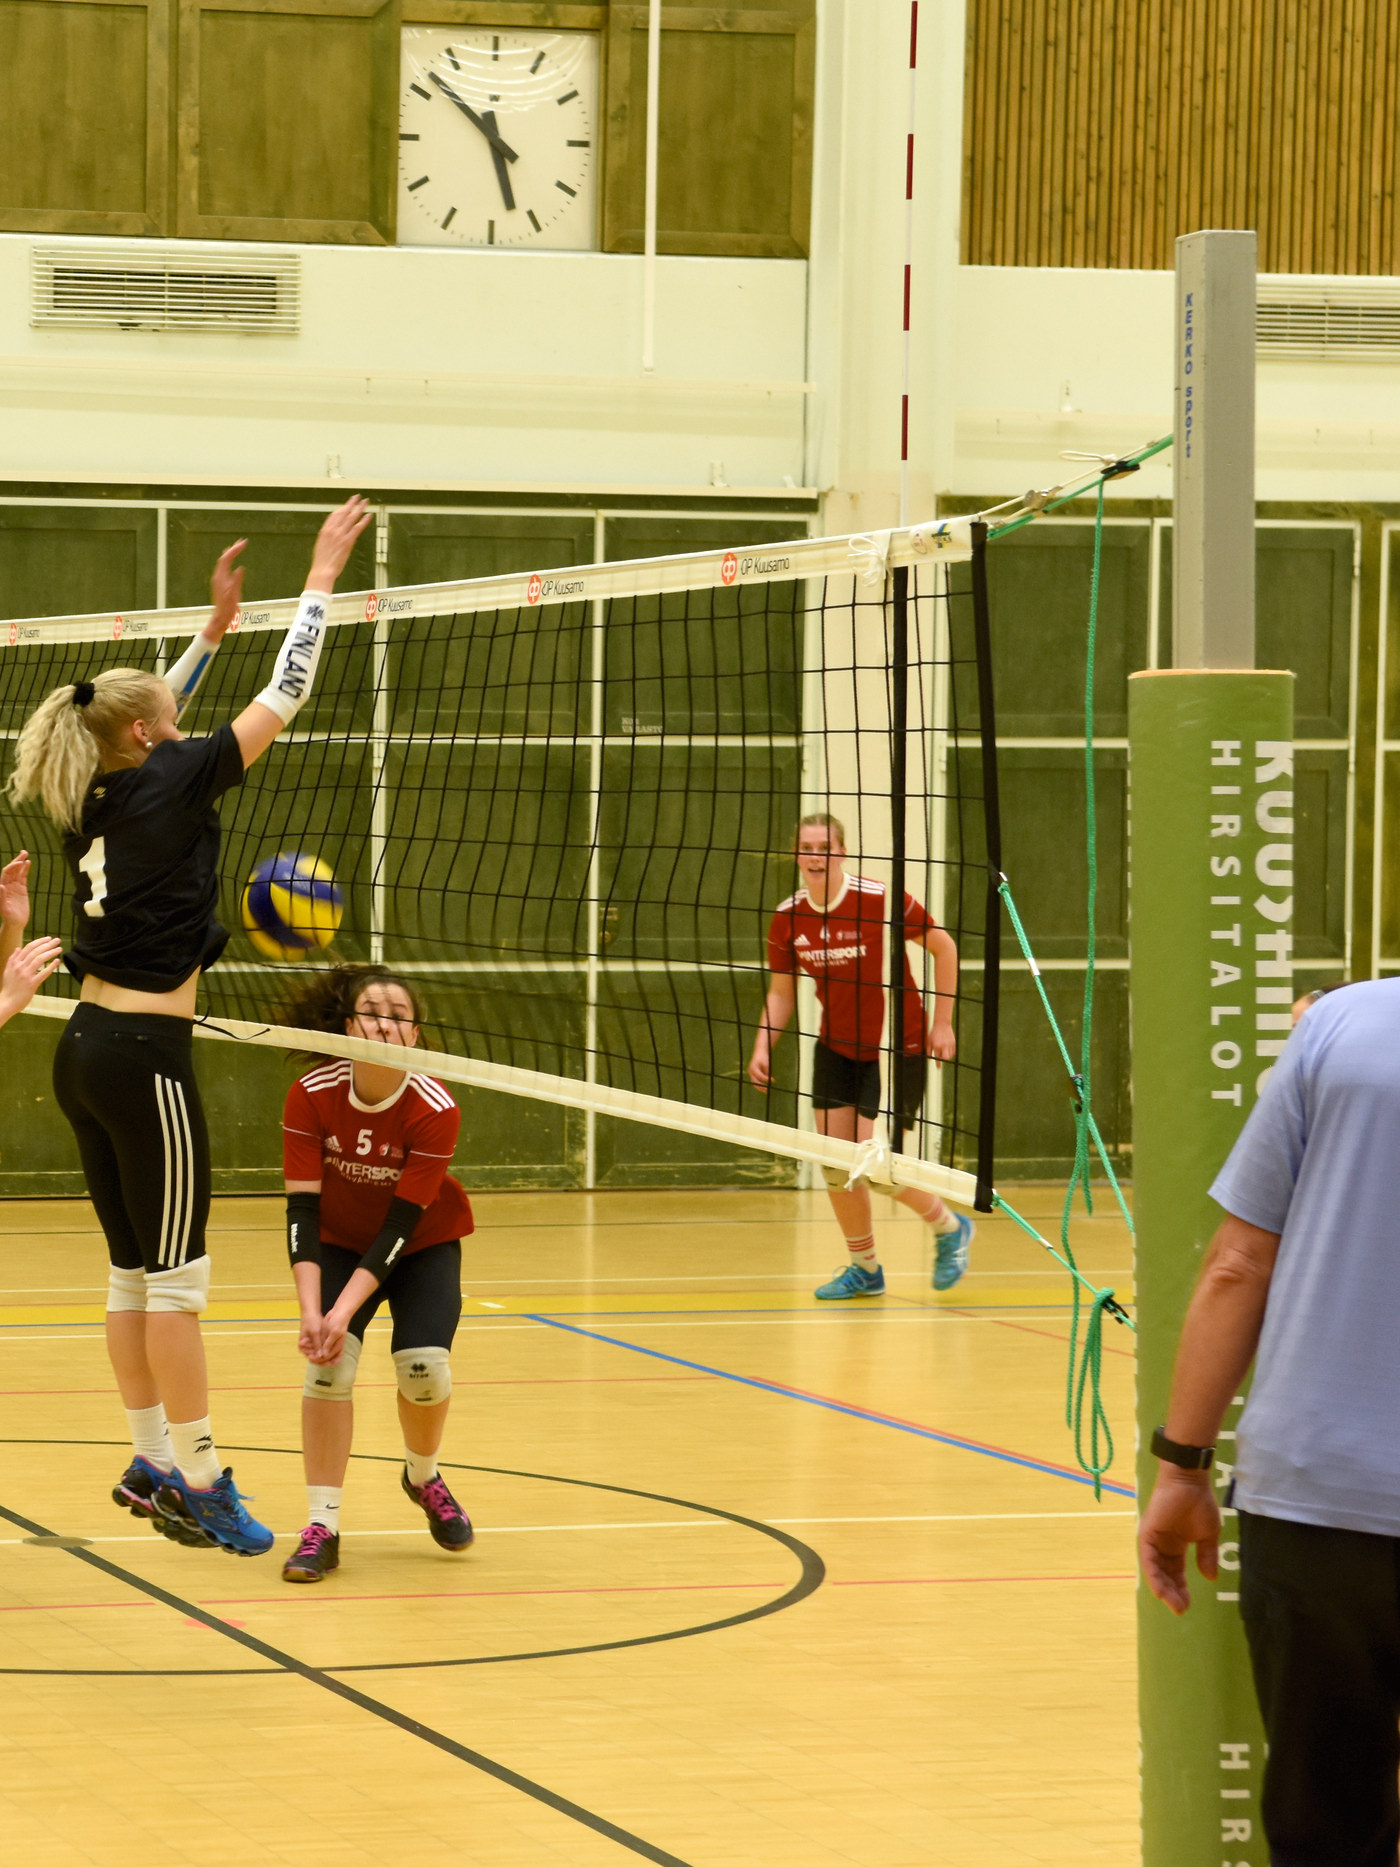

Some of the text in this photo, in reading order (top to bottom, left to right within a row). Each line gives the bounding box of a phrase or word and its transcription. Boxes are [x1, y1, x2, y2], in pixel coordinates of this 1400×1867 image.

[1185, 293, 1193, 458] KERKO sport
[554, 580, 584, 595] Kuusamo
[754, 557, 788, 573] Kuusamo
[278, 622, 320, 699] FINLAND
[79, 836, 108, 917] 1
[1210, 740, 1242, 1107] HIRSITALOT
[356, 1129, 373, 1155] 5
[332, 1157, 402, 1181] INTERSPO
